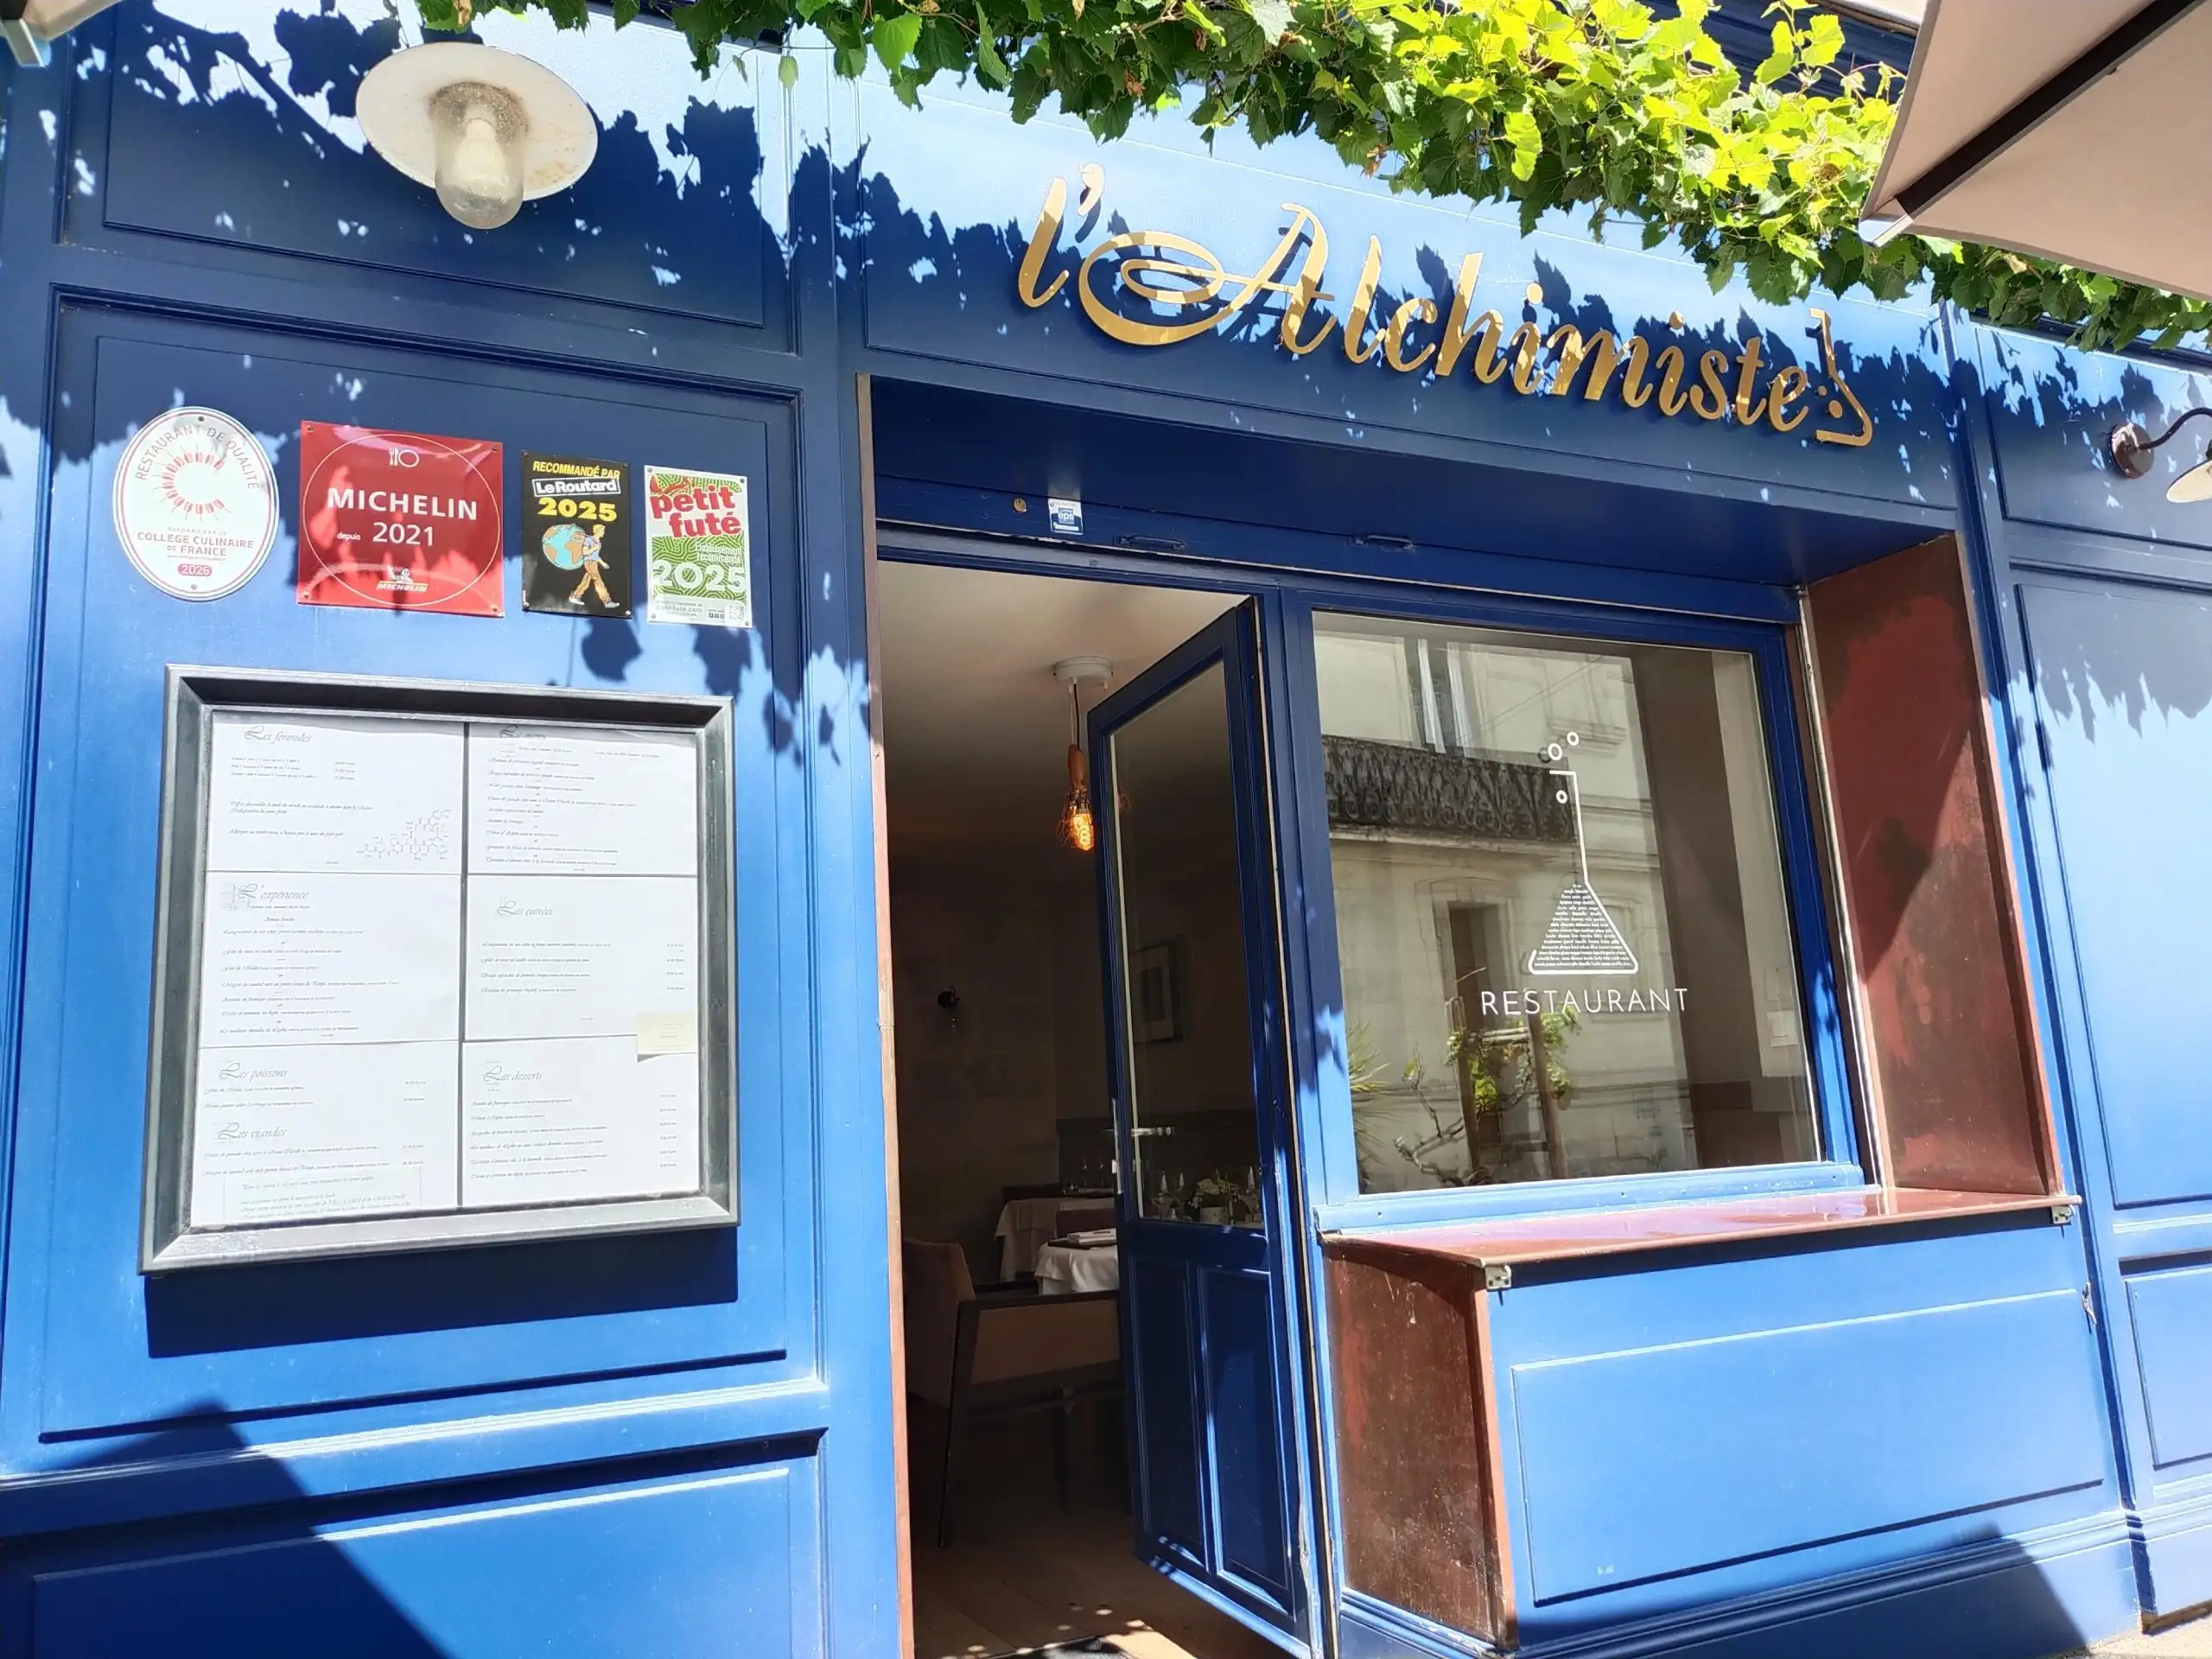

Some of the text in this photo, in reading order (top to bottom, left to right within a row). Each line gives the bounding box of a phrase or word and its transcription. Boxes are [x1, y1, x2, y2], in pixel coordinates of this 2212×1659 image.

[1018, 162, 1809, 433] l'Alchimiste
[135, 424, 201, 480] RESTAURANT
[207, 427, 226, 442] DE
[532, 461, 620, 480] RECOMMANDÉ PAR
[327, 487, 477, 521] MICHELIN
[537, 497, 618, 522] 2025
[650, 485, 736, 519] petit
[337, 522, 434, 547] depuis 2021
[669, 512, 742, 537] futé
[181, 544, 227, 556] FRANCE
[193, 536, 254, 549] CULINAIRE
[376, 583, 429, 593] MICHELIN
[652, 560, 746, 594] 2025
[243, 725, 313, 744] Les formules
[496, 899, 524, 917] Les
[1480, 988, 1688, 1016] RESTAURANT
[219, 1062, 289, 1083] Les poissons
[483, 1065, 544, 1082] Les desserts
[218, 1122, 287, 1140] Les viandes
